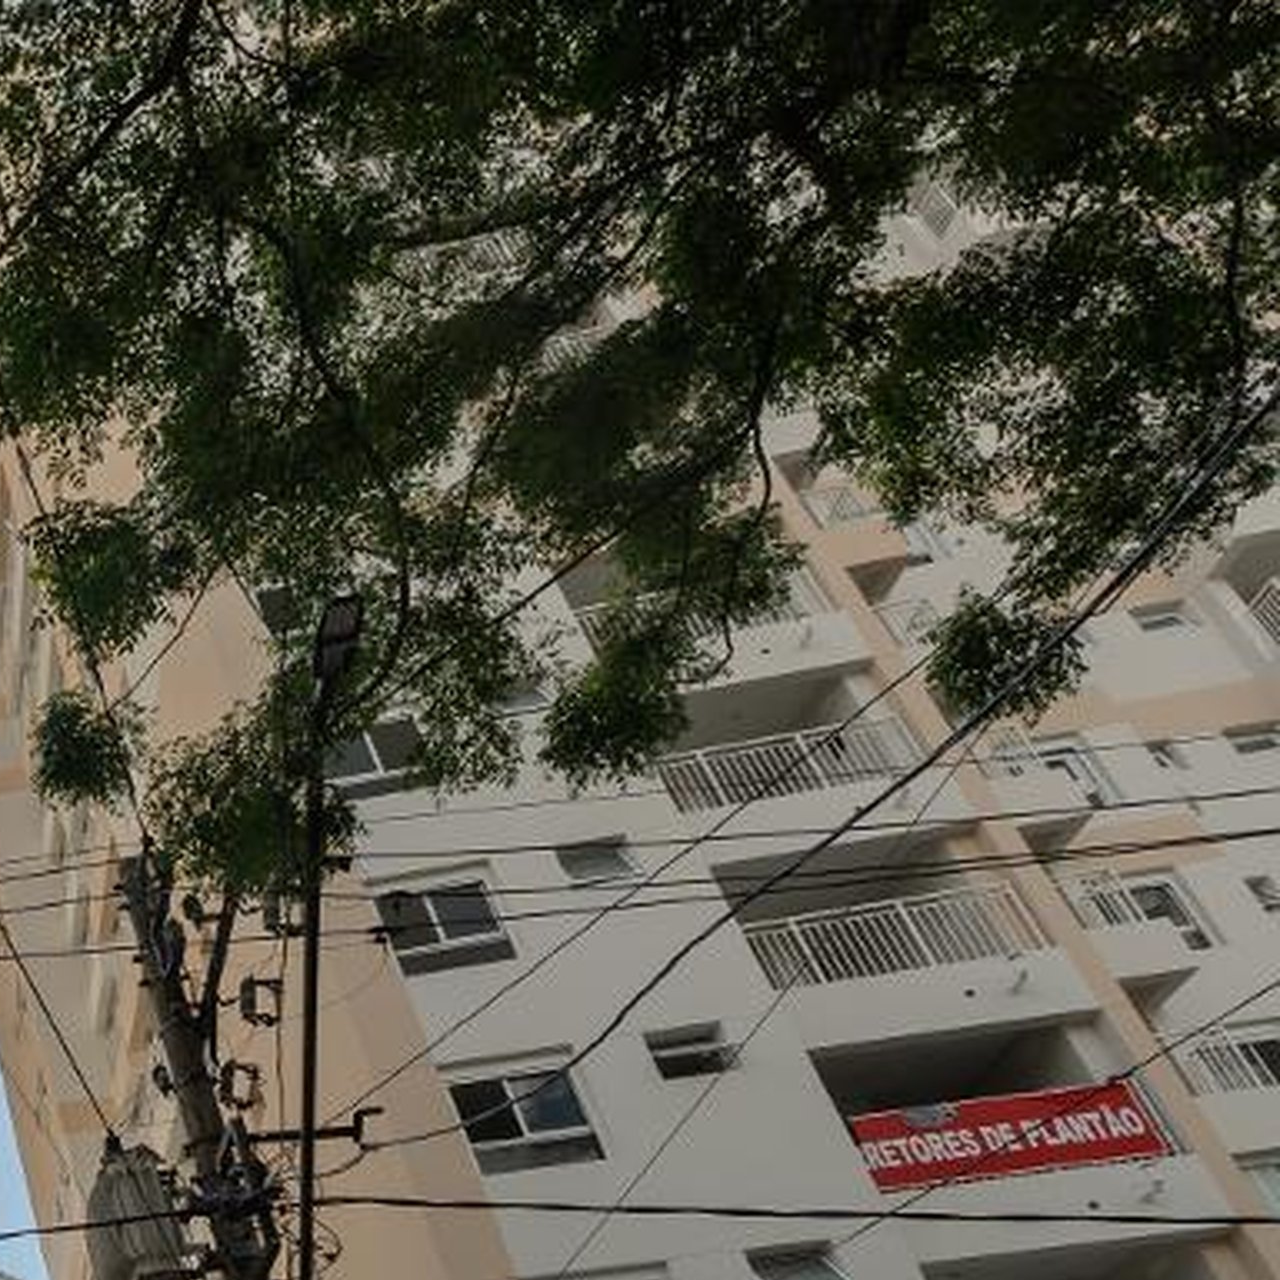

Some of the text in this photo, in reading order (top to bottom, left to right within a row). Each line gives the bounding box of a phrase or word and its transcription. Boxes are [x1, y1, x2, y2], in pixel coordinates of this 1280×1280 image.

[862, 1105, 1146, 1171] RETORES DE PLANTÃO
